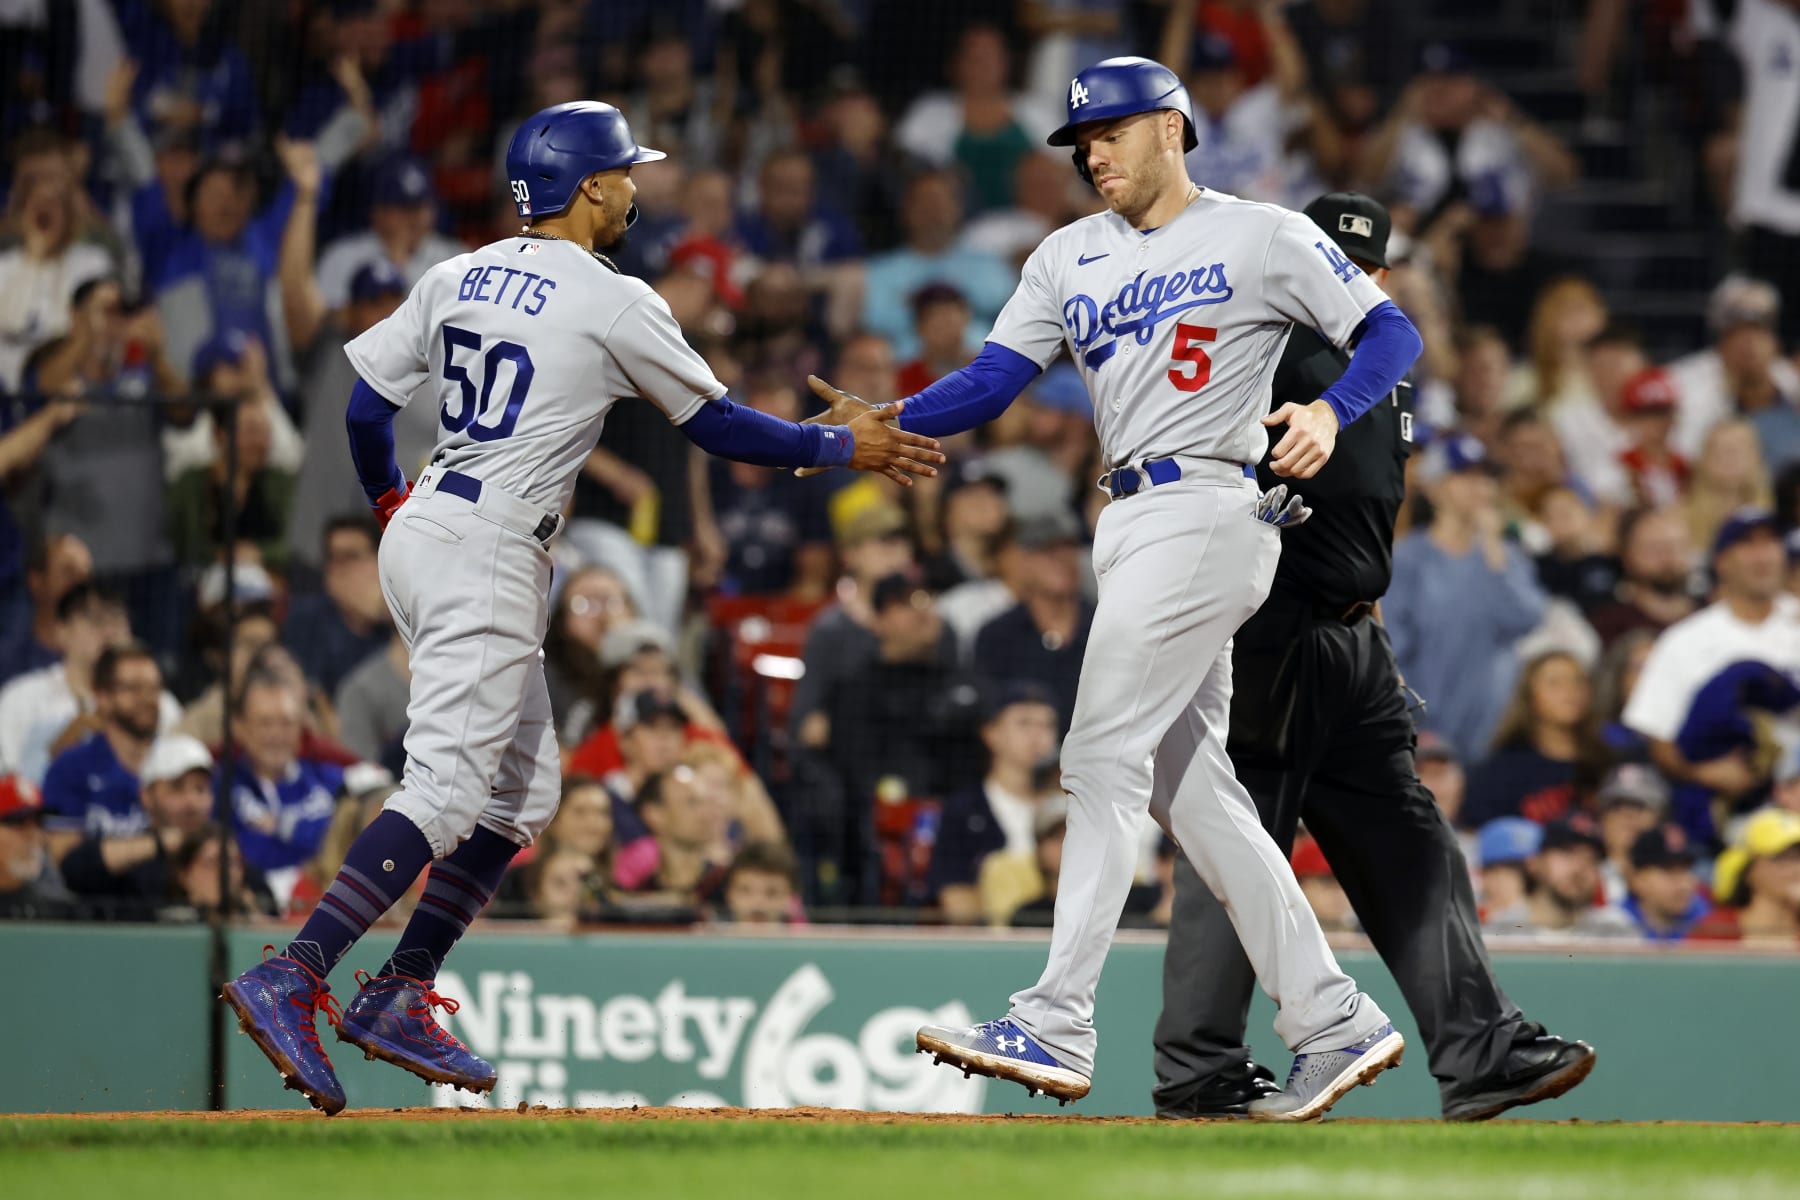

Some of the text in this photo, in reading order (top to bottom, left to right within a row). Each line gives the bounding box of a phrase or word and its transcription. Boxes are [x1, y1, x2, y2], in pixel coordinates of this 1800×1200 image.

[1070, 78, 1090, 110] LA
[510, 179, 530, 203] 50
[458, 266, 556, 316] BETTS
[1315, 241, 1361, 283] LA
[1063, 262, 1234, 366] Dodgers
[440, 324, 535, 443] 50
[1167, 323, 1218, 393] 5
[433, 970, 757, 1079] Ninety
